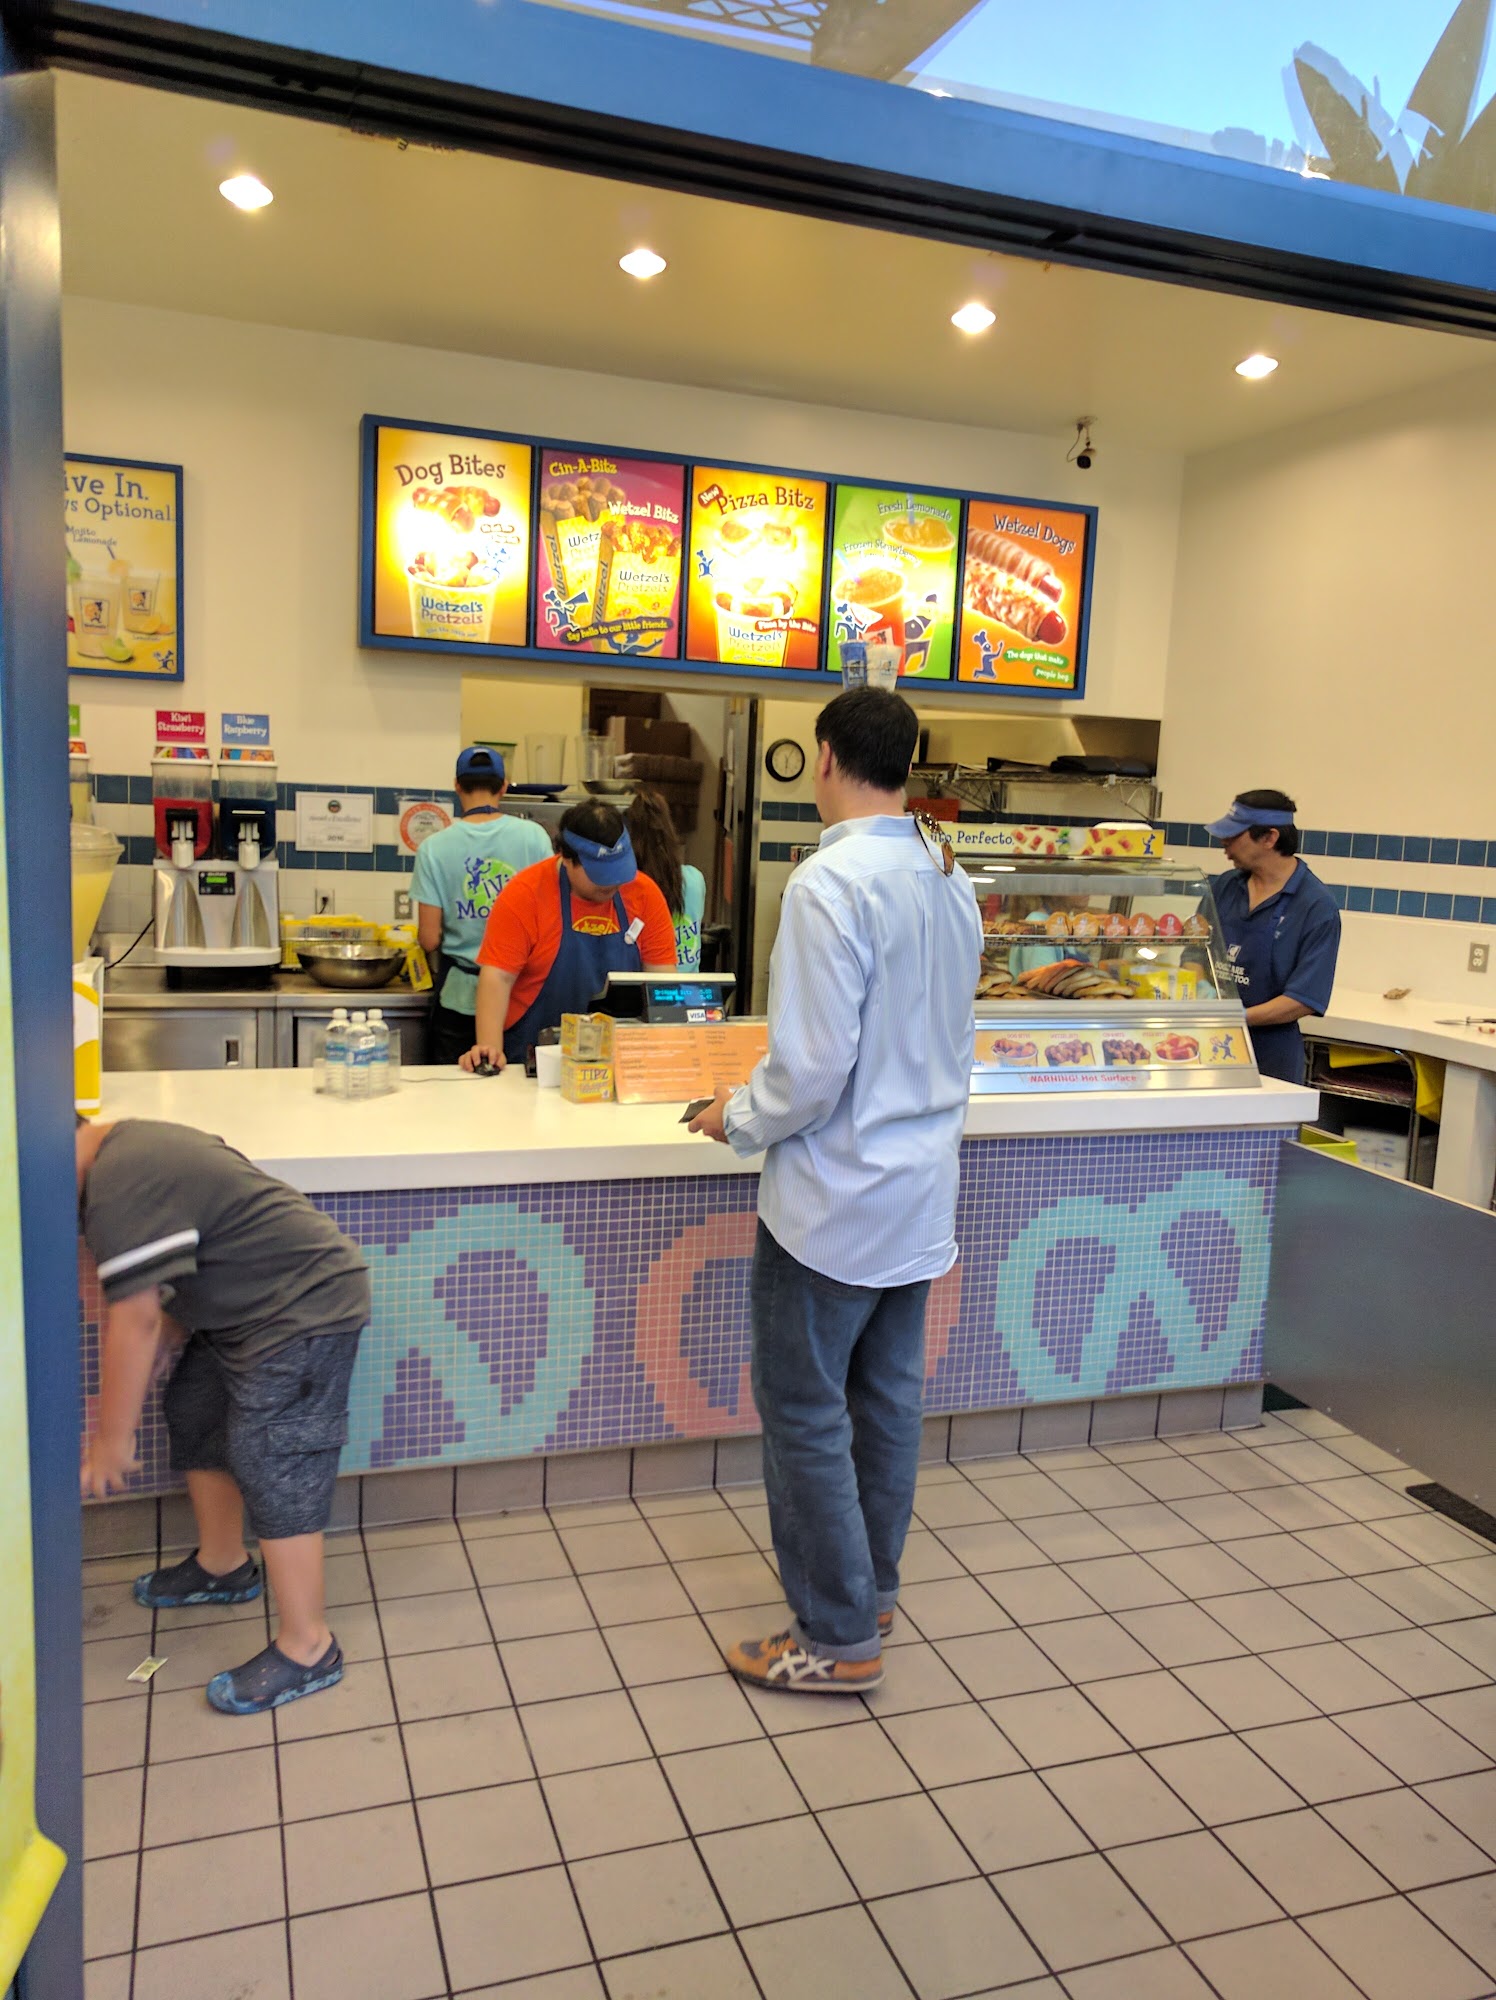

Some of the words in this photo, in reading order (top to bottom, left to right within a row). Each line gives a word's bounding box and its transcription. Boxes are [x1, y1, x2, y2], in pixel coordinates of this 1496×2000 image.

[394, 463, 443, 487] Dog
[449, 454, 506, 479] Bites
[549, 458, 617, 477] Cin-A-Bitz
[115, 472, 149, 501] In.
[700, 486, 720, 504] New
[717, 492, 769, 516] Pizza
[775, 486, 815, 511] Bitz
[608, 500, 651, 518] Wetzel
[653, 504, 679, 525] Bitz
[878, 499, 903, 517] Fresh
[994, 514, 1041, 541] Wetzel
[1043, 525, 1077, 556] Dogs
[843, 541, 874, 554] Frozen
[619, 570, 671, 584] Wetzel's
[421, 596, 484, 613] Wetzel's
[421, 608, 484, 625] Pretzels
[566, 631, 580, 642] Say
[581, 626, 599, 639] hello
[599, 624, 609, 634] to
[609, 624, 622, 633] our
[622, 620, 641, 631] little
[1006, 650, 1019, 659] The
[1019, 650, 1033, 662] dogs
[1034, 652, 1047, 662] that
[1048, 656, 1064, 666] make
[1035, 668, 1056, 680] people
[171, 711, 192, 722] Kiwi
[236, 715, 255, 725] Blue
[157, 721, 205, 735] Strawberry
[223, 723, 268, 738] Raspberry
[957, 830, 1015, 845] Perfecto.
[1235, 974, 1250, 985] TOO
[689, 1011, 705, 1020] VISA
[581, 1068, 609, 1081] TIPZ
[1029, 1074, 1079, 1083] WARNING!
[1081, 1074, 1098, 1082] Hot
[1101, 1073, 1137, 1082] Surface
